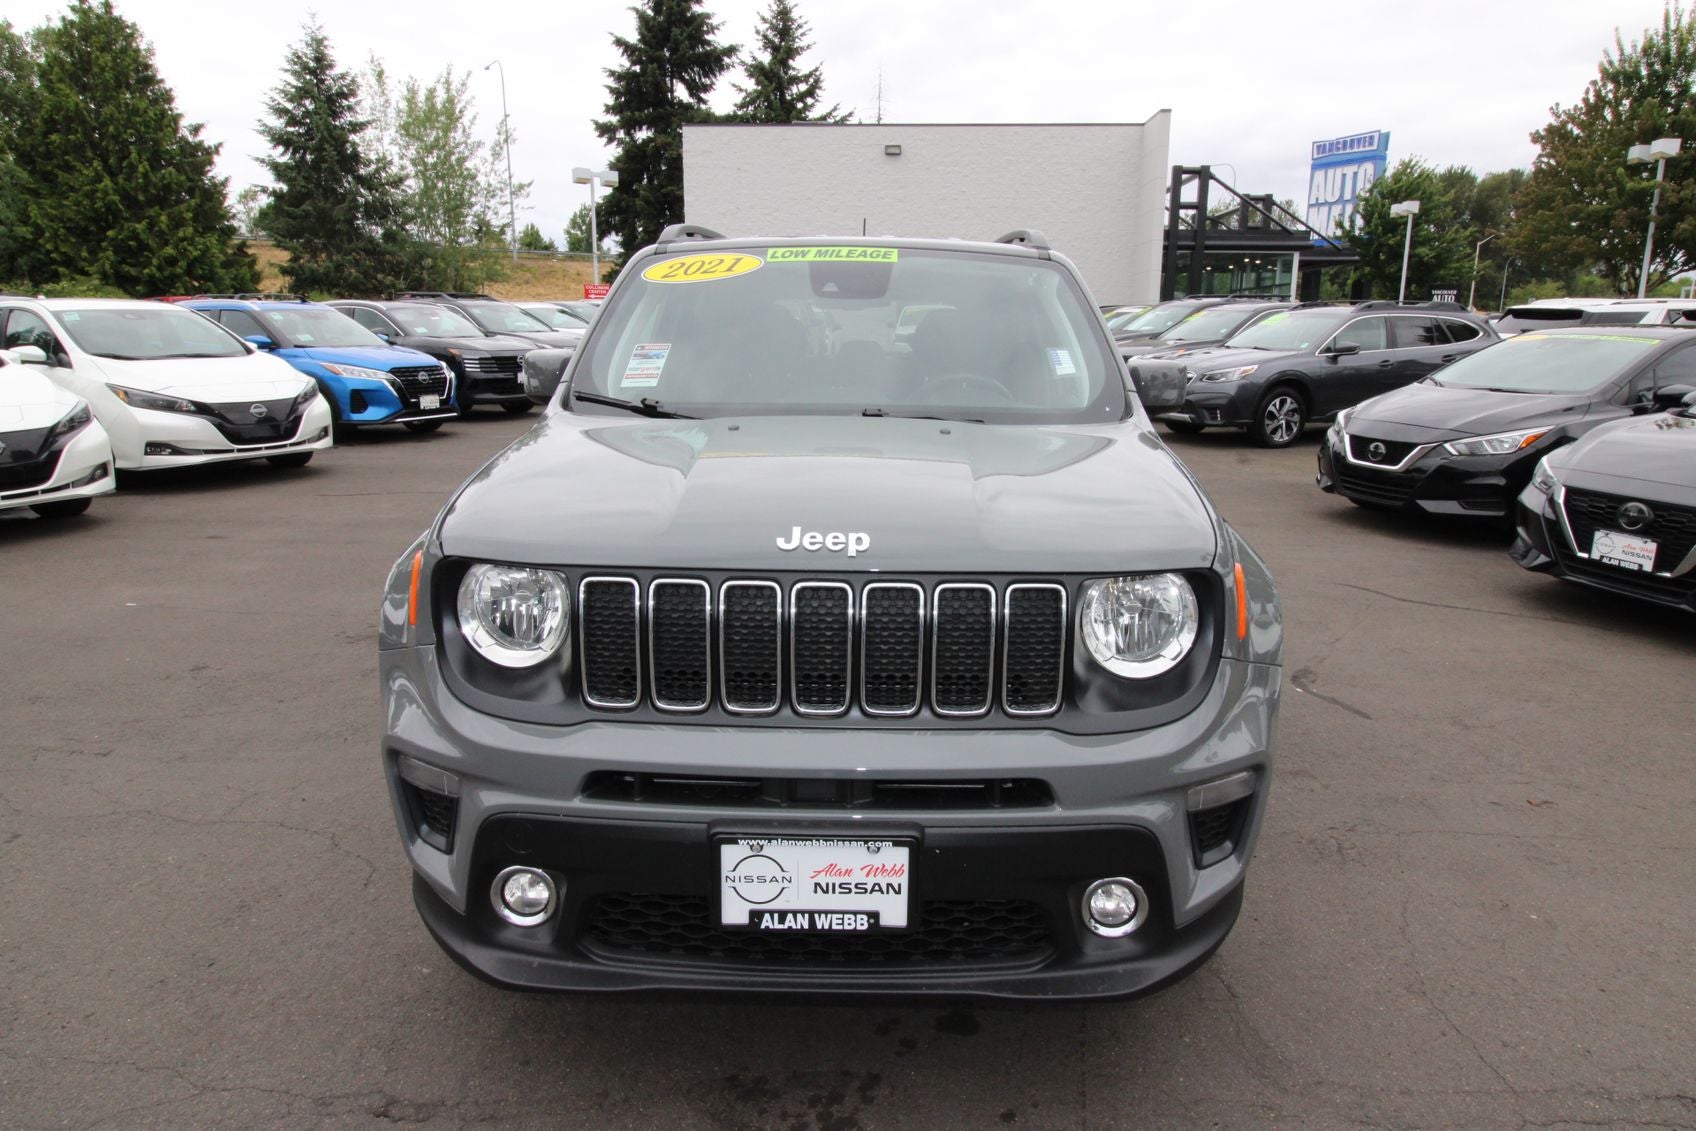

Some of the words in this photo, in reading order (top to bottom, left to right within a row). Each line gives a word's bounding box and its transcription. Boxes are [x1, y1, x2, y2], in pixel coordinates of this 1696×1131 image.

[1315, 135, 1376, 156] VANCOUVER
[1309, 160, 1375, 205] AUTO
[1307, 203, 1365, 241] MA
[769, 249, 809, 260] LOW
[812, 249, 895, 261] MILEAGE
[660, 257, 743, 279] 2021
[1432, 294, 1455, 302] AUTO
[776, 526, 871, 558] Jeep
[1602, 556, 1619, 566] ALAN
[1621, 549, 1653, 561] NISSAN
[737, 838, 893, 848] www.alanwebbnissan.com
[809, 863, 853, 879] Alan
[860, 863, 905, 878] Webb
[725, 875, 793, 884] NISSAN
[813, 882, 902, 895] NISSAN
[760, 912, 810, 930] ALAN
[814, 914, 869, 930] WEBB
